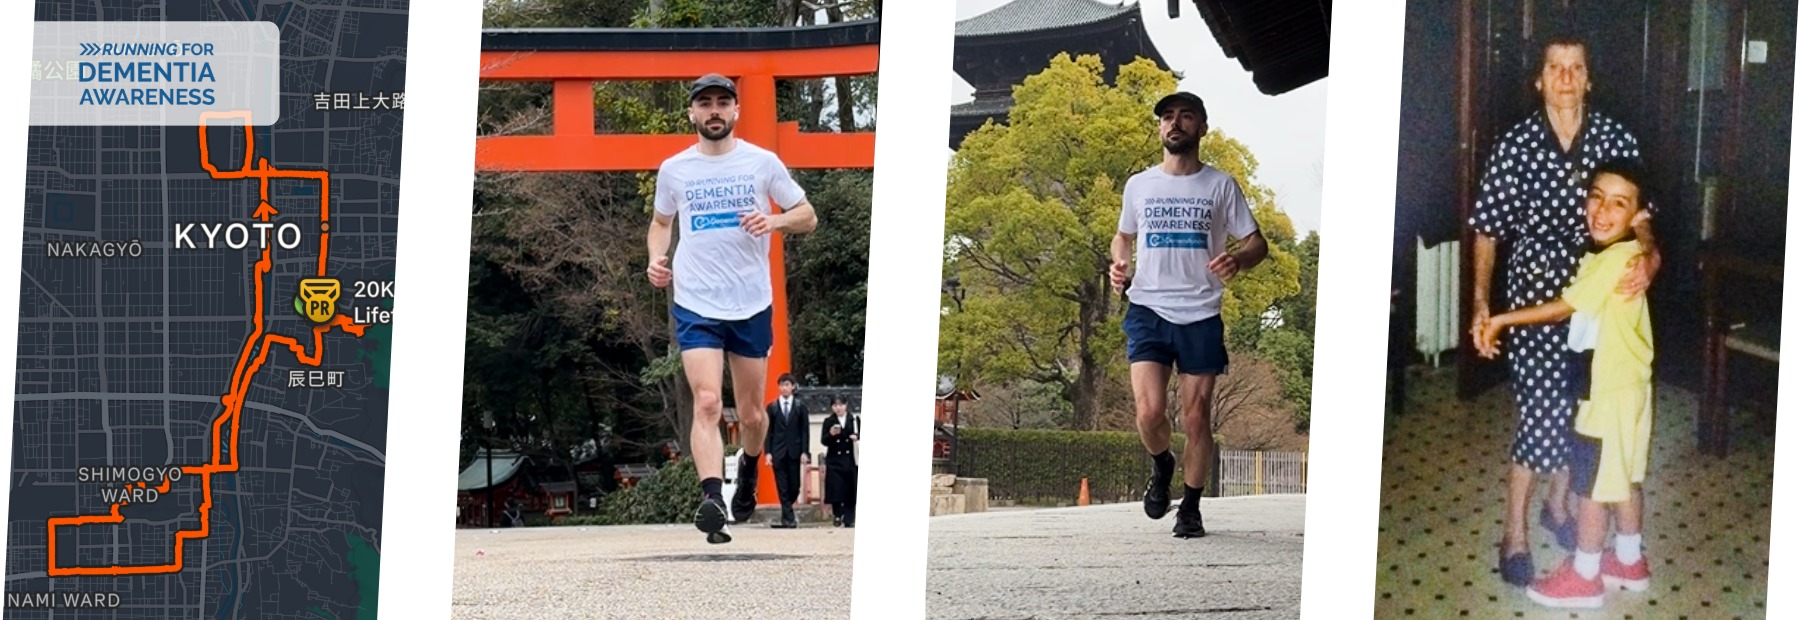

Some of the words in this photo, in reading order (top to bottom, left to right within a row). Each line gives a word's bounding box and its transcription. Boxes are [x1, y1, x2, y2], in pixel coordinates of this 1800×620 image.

[738, 174, 755, 182] FOR
[686, 184, 755, 200] DEMENTIA
[689, 197, 755, 212] AWARENESS
[1156, 197, 1195, 205] RUNNING
[1197, 198, 1213, 206] FOR
[1145, 207, 1212, 219] DEMENTIA
[1143, 220, 1212, 231] AWARENESS
[175, 223, 301, 249] KYOTO
[47, 239, 142, 257] NAKAGYŌ
[354, 281, 395, 298] 20K
[310, 300, 330, 316] PR
[78, 467, 182, 482] SHIMOGYO
[101, 488, 159, 503] WARD
[8, 593, 55, 607] NAMI
[63, 593, 120, 607] WARD
